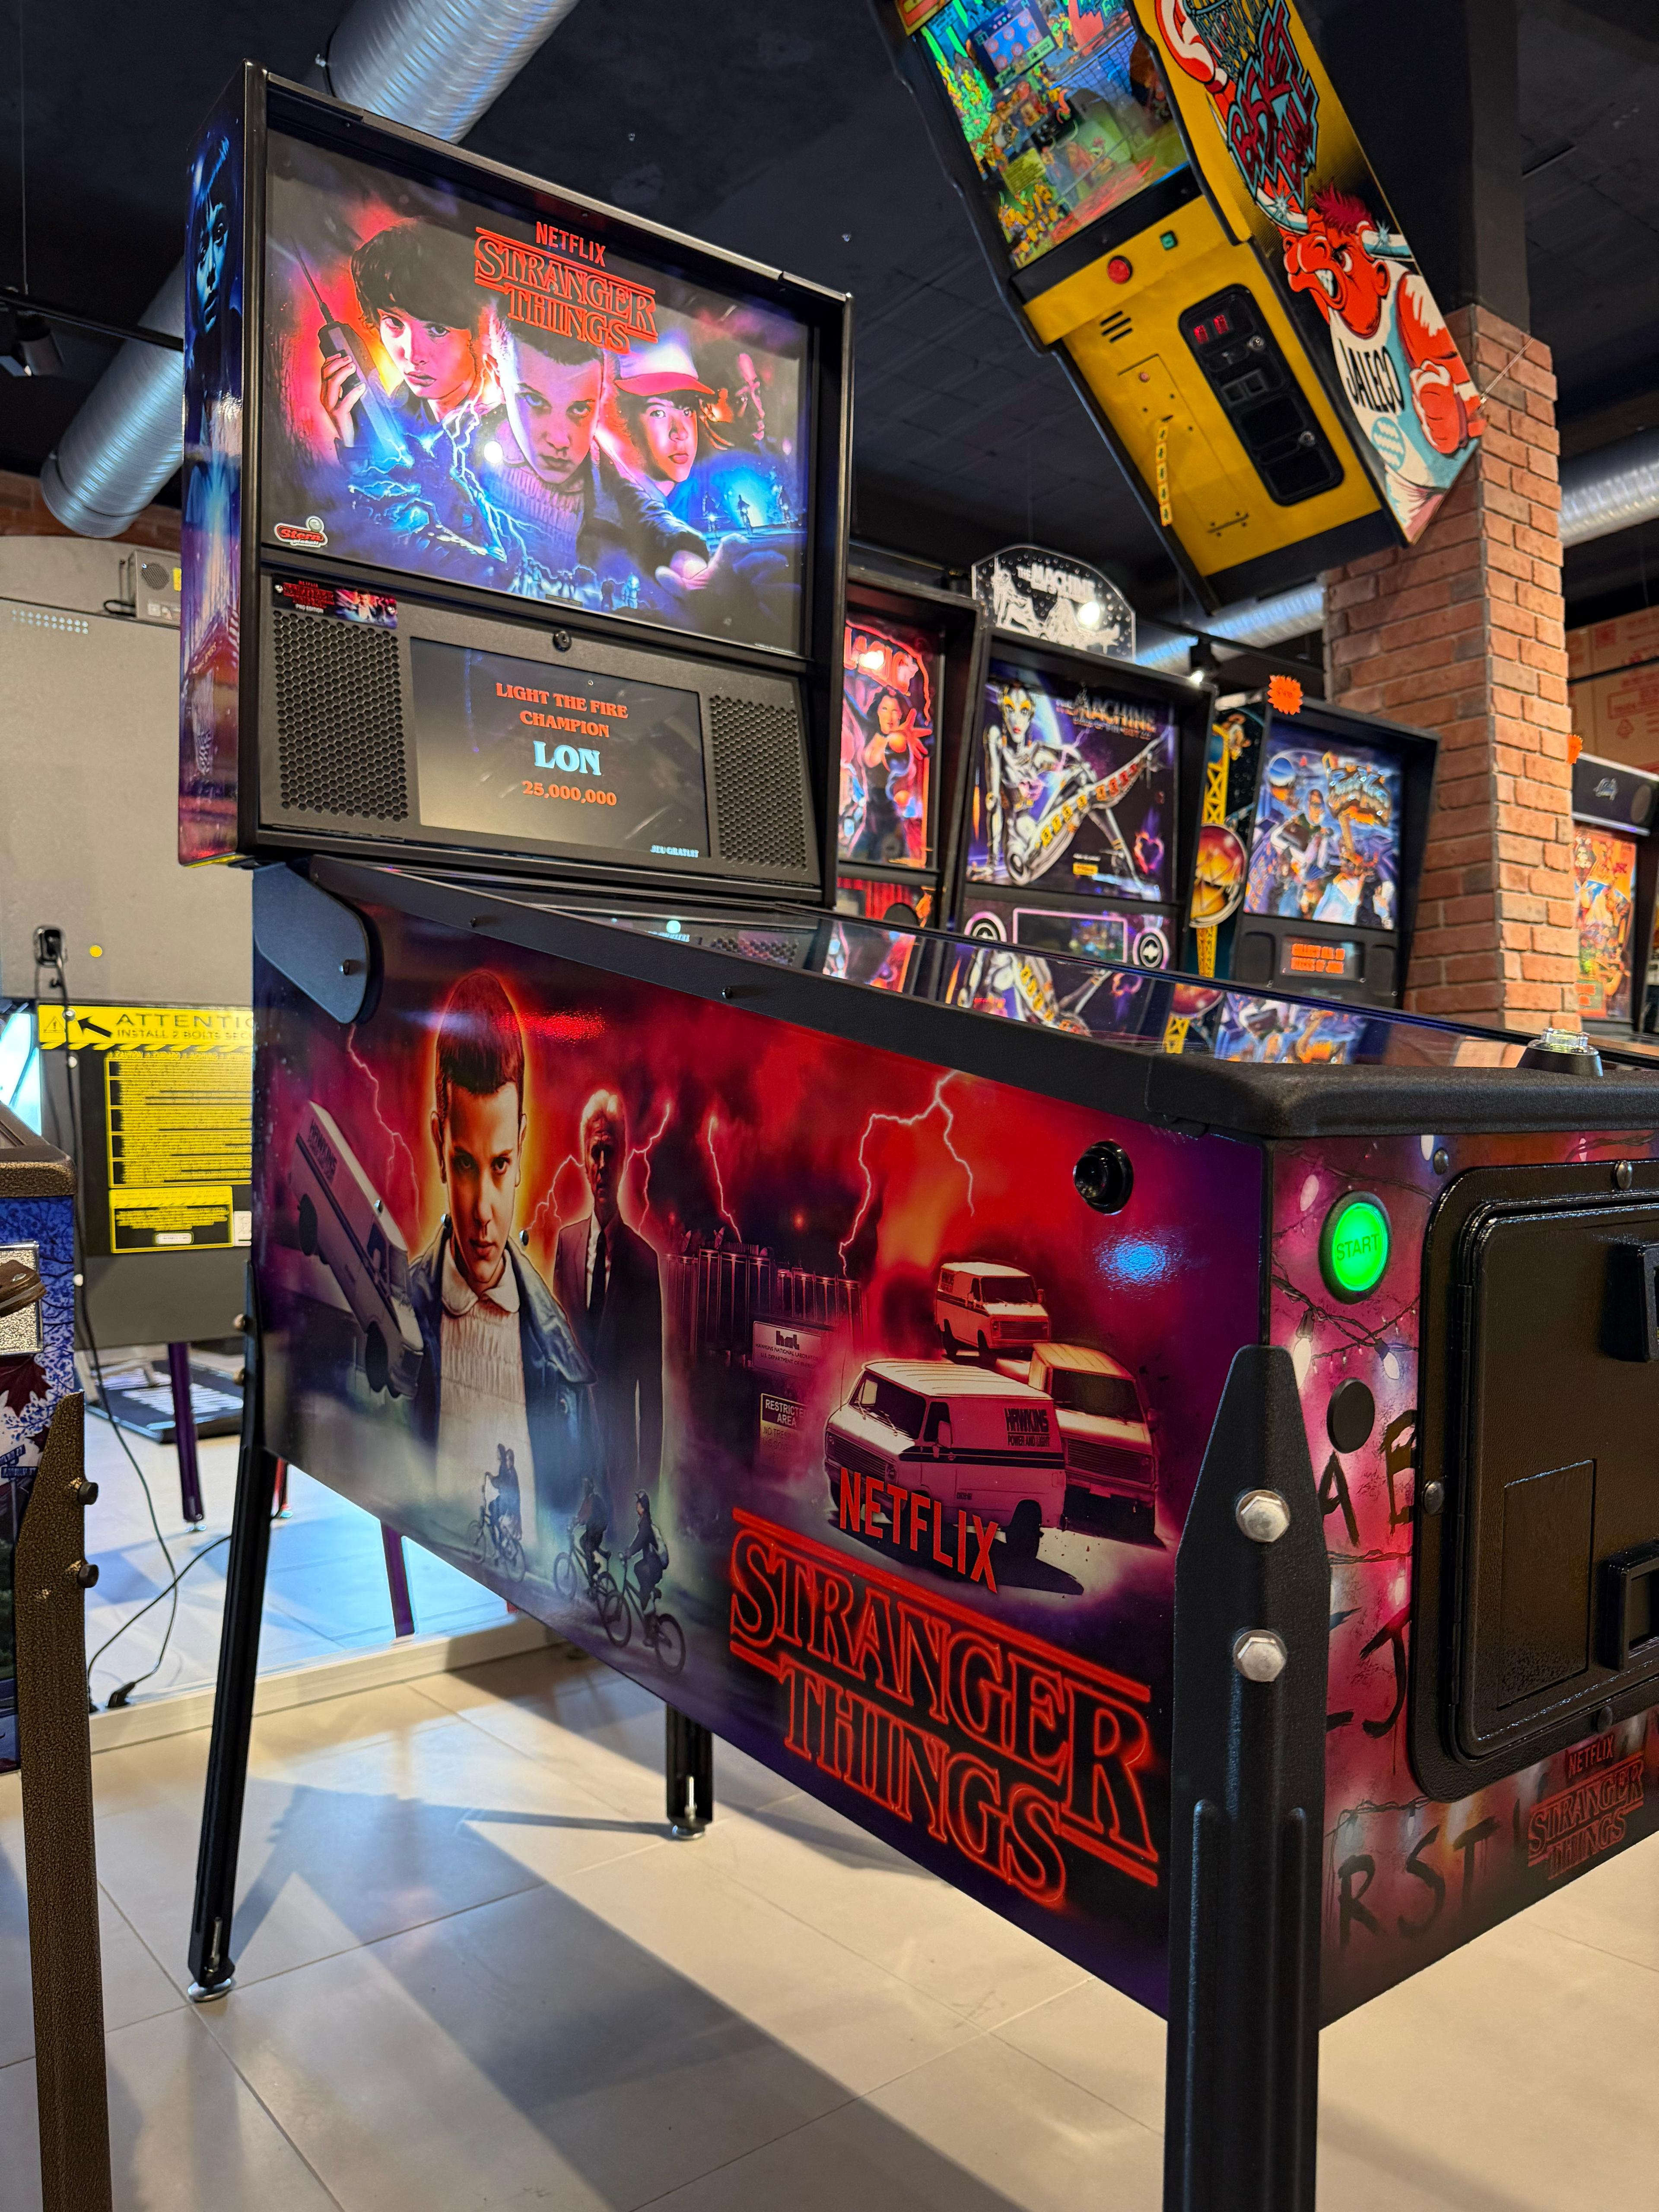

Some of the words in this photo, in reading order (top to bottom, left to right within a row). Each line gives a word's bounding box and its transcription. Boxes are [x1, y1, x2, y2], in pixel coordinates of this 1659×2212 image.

[535, 221, 606, 267] NETFLIX
[474, 235, 658, 337] STRANGER
[505, 283, 630, 356] THINGS
[1339, 337, 1405, 413] JALECO
[281, 528, 321, 541] Stern
[496, 682, 550, 704] LIGHT
[553, 693, 587, 712] THE
[590, 699, 629, 718] FIRE
[519, 710, 610, 737] CHAMPION
[533, 740, 602, 776] LON
[521, 780, 617, 806] 25,000,000
[117, 1029, 168, 1039] INSTALL
[183, 1031, 221, 1040] BOLTS
[226, 1032, 253, 1040] SEC
[1336, 1233, 1379, 1262] START
[774, 1347, 794, 1356] NATIONAL
[776, 1413, 797, 1427] AREA
[1004, 1408, 1049, 1433] HAWKINS
[1007, 1434, 1024, 1446] POWER
[1025, 1435, 1036, 1447] AND
[839, 1467, 998, 1594] NETFLIX
[730, 1528, 1159, 1862] STRANGER
[1568, 1735, 1615, 1779] NETFLIX
[778, 1651, 1067, 1909] THINGS
[1528, 1759, 1644, 1858] STRANGER
[1547, 1808, 1626, 1880] THINGS
